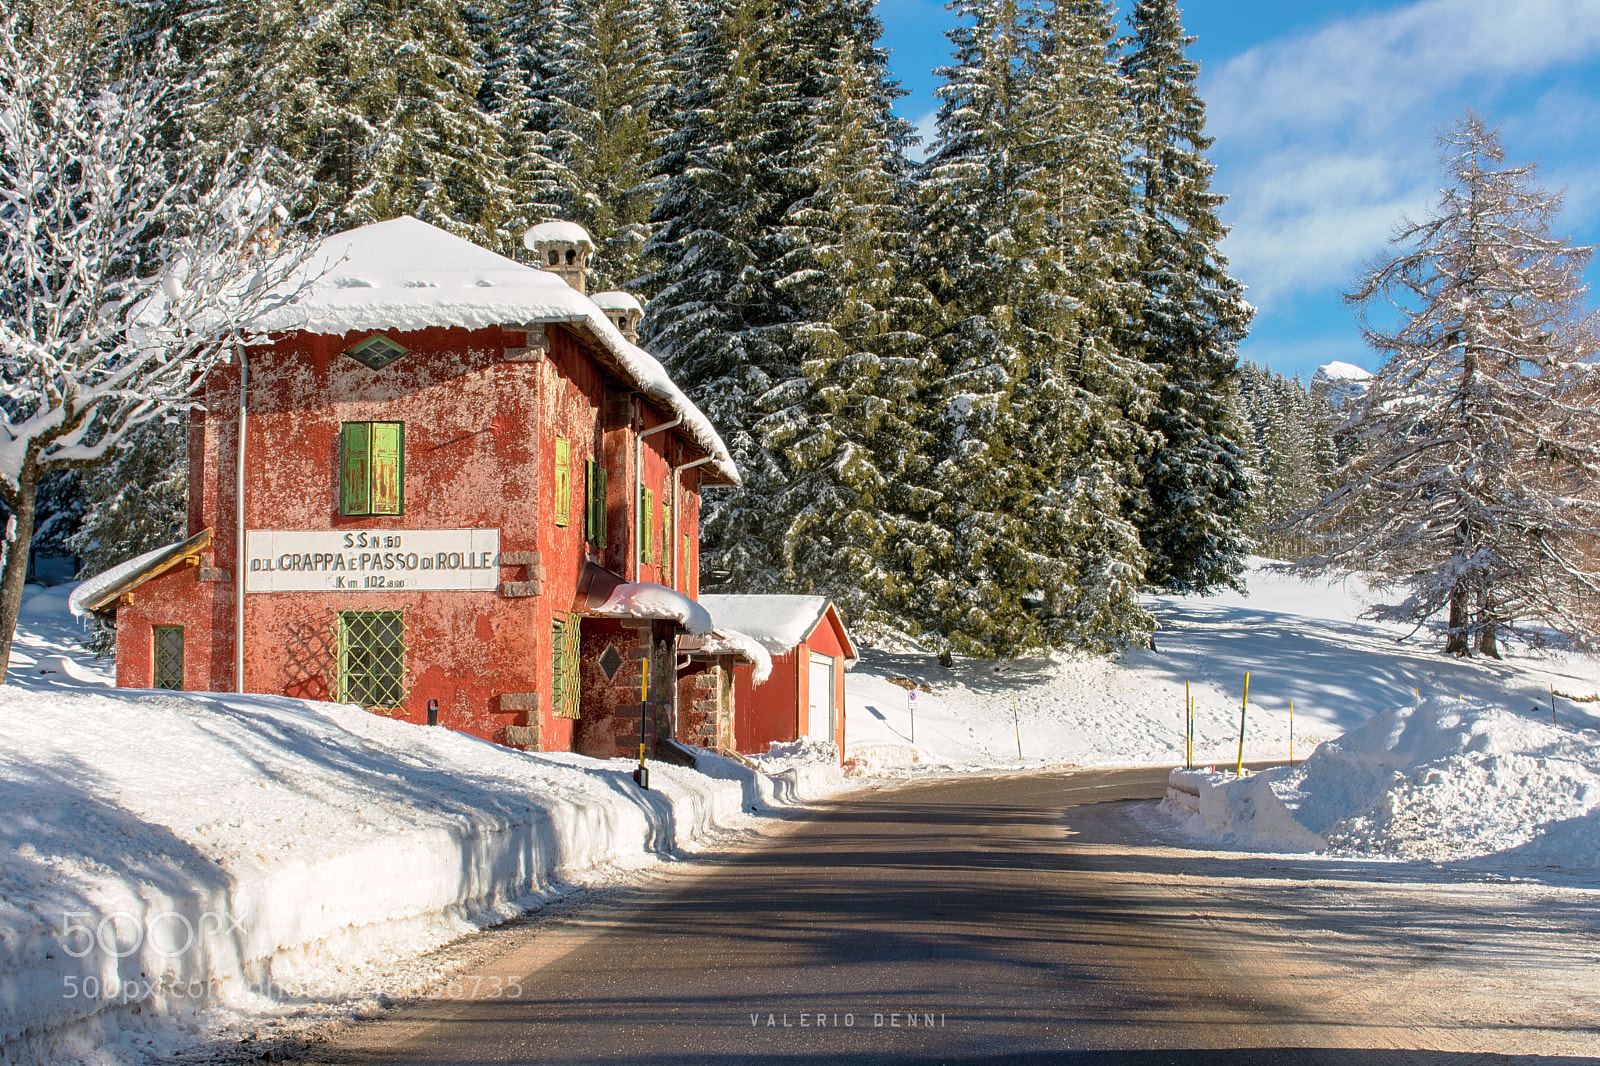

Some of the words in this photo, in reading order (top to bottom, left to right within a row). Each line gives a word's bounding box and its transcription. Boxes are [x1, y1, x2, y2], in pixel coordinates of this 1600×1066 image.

[278, 553, 346, 571] GRAPPA
[358, 552, 419, 571] PASSO
[420, 557, 434, 570] DI
[436, 551, 493, 571] ROLLE
